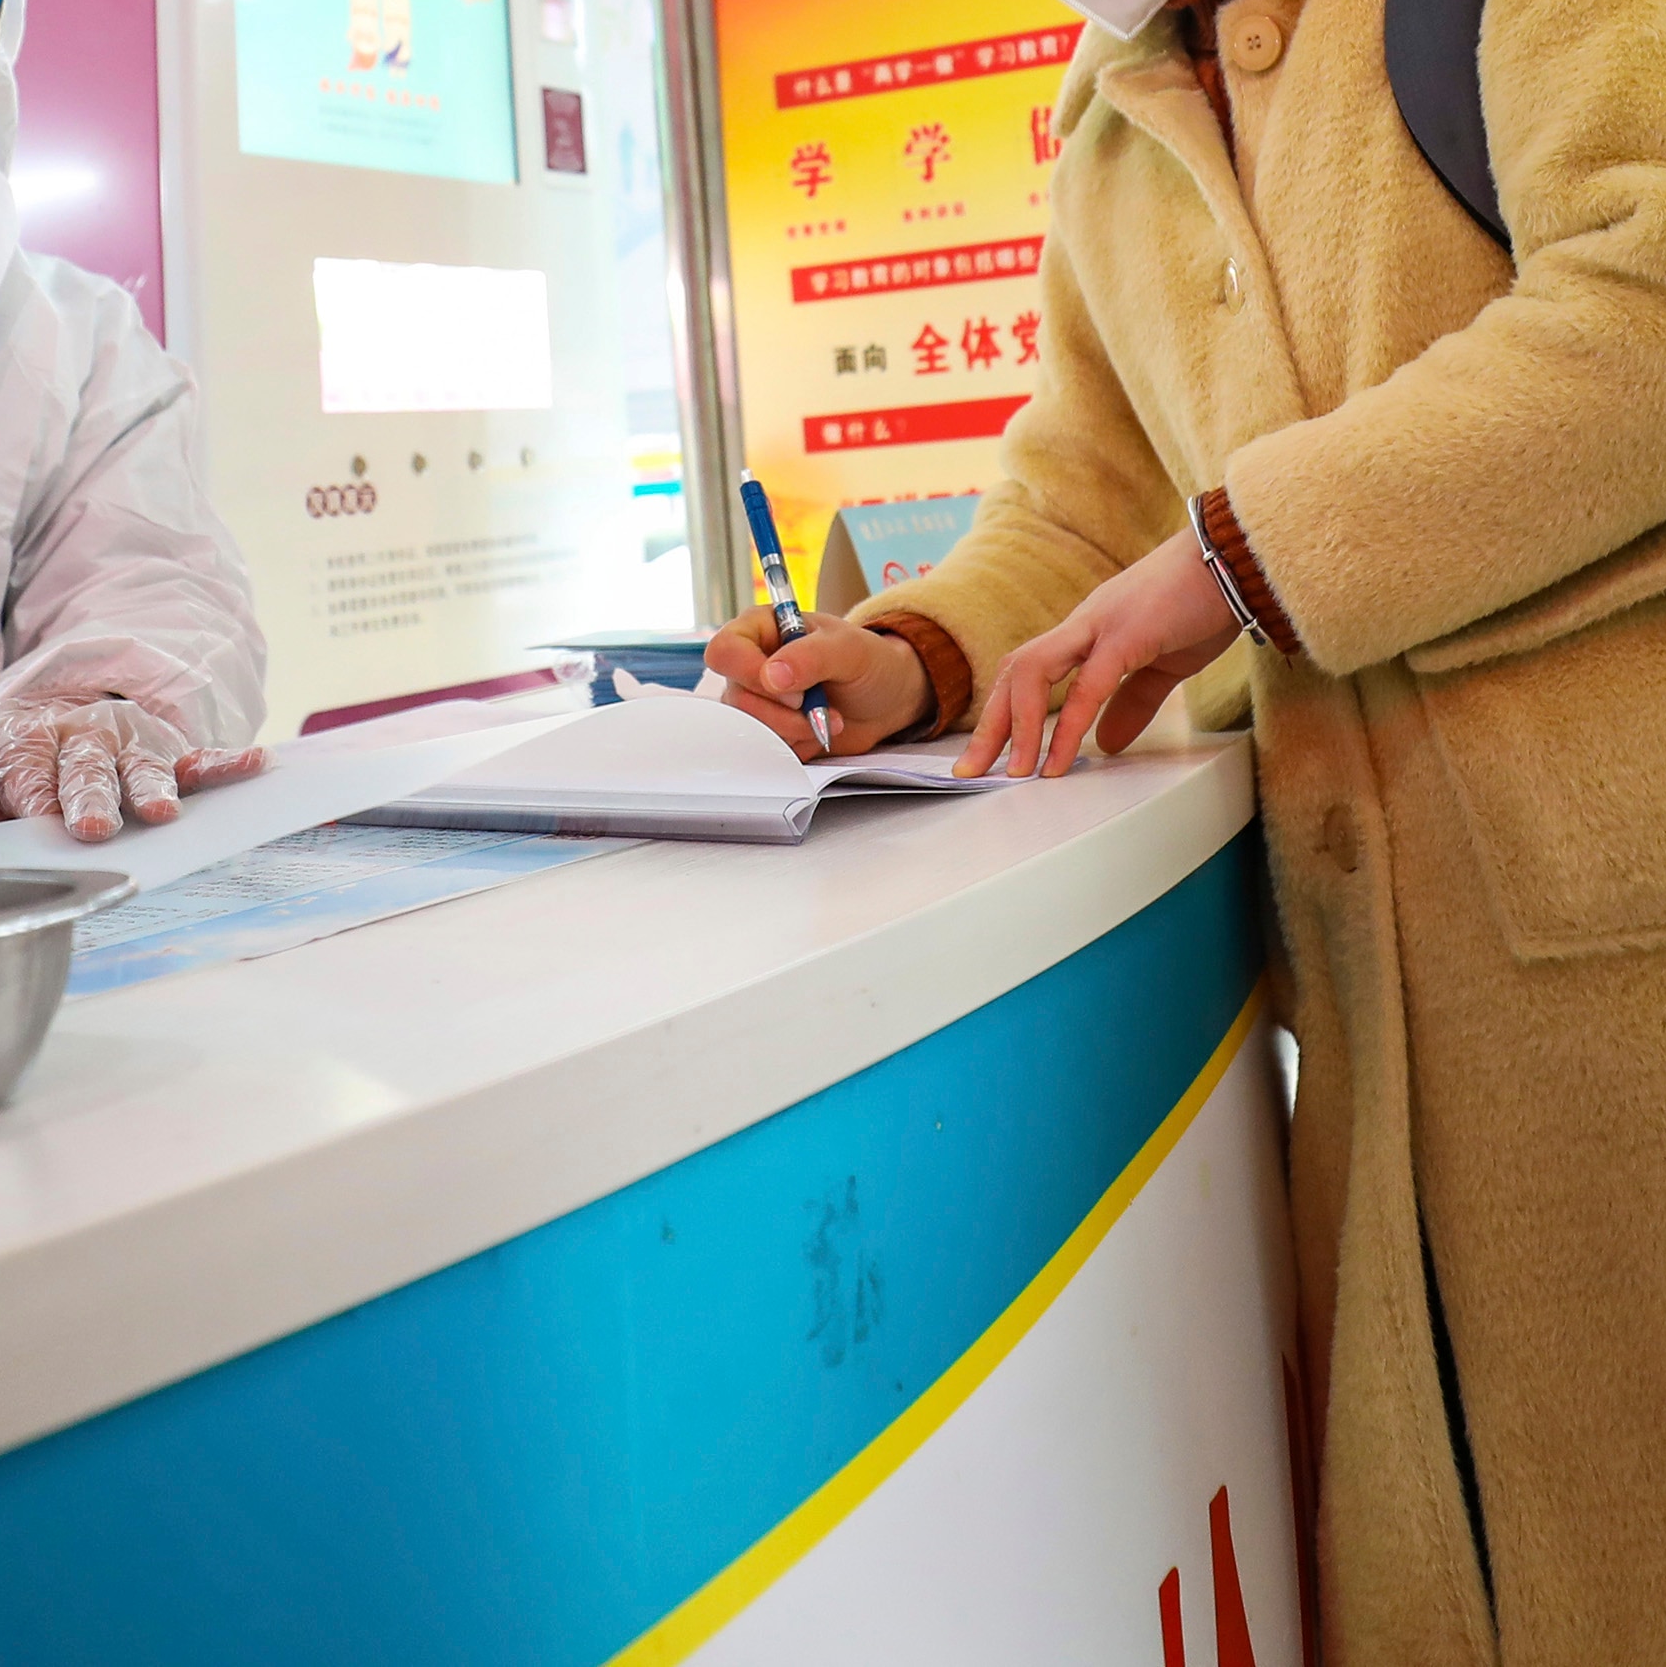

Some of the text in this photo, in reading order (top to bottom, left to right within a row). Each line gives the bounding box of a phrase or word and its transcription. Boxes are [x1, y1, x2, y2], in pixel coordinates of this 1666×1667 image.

[791, 141, 832, 198] 学
[904, 122, 951, 182] 学
[834, 343, 888, 376] 面向
